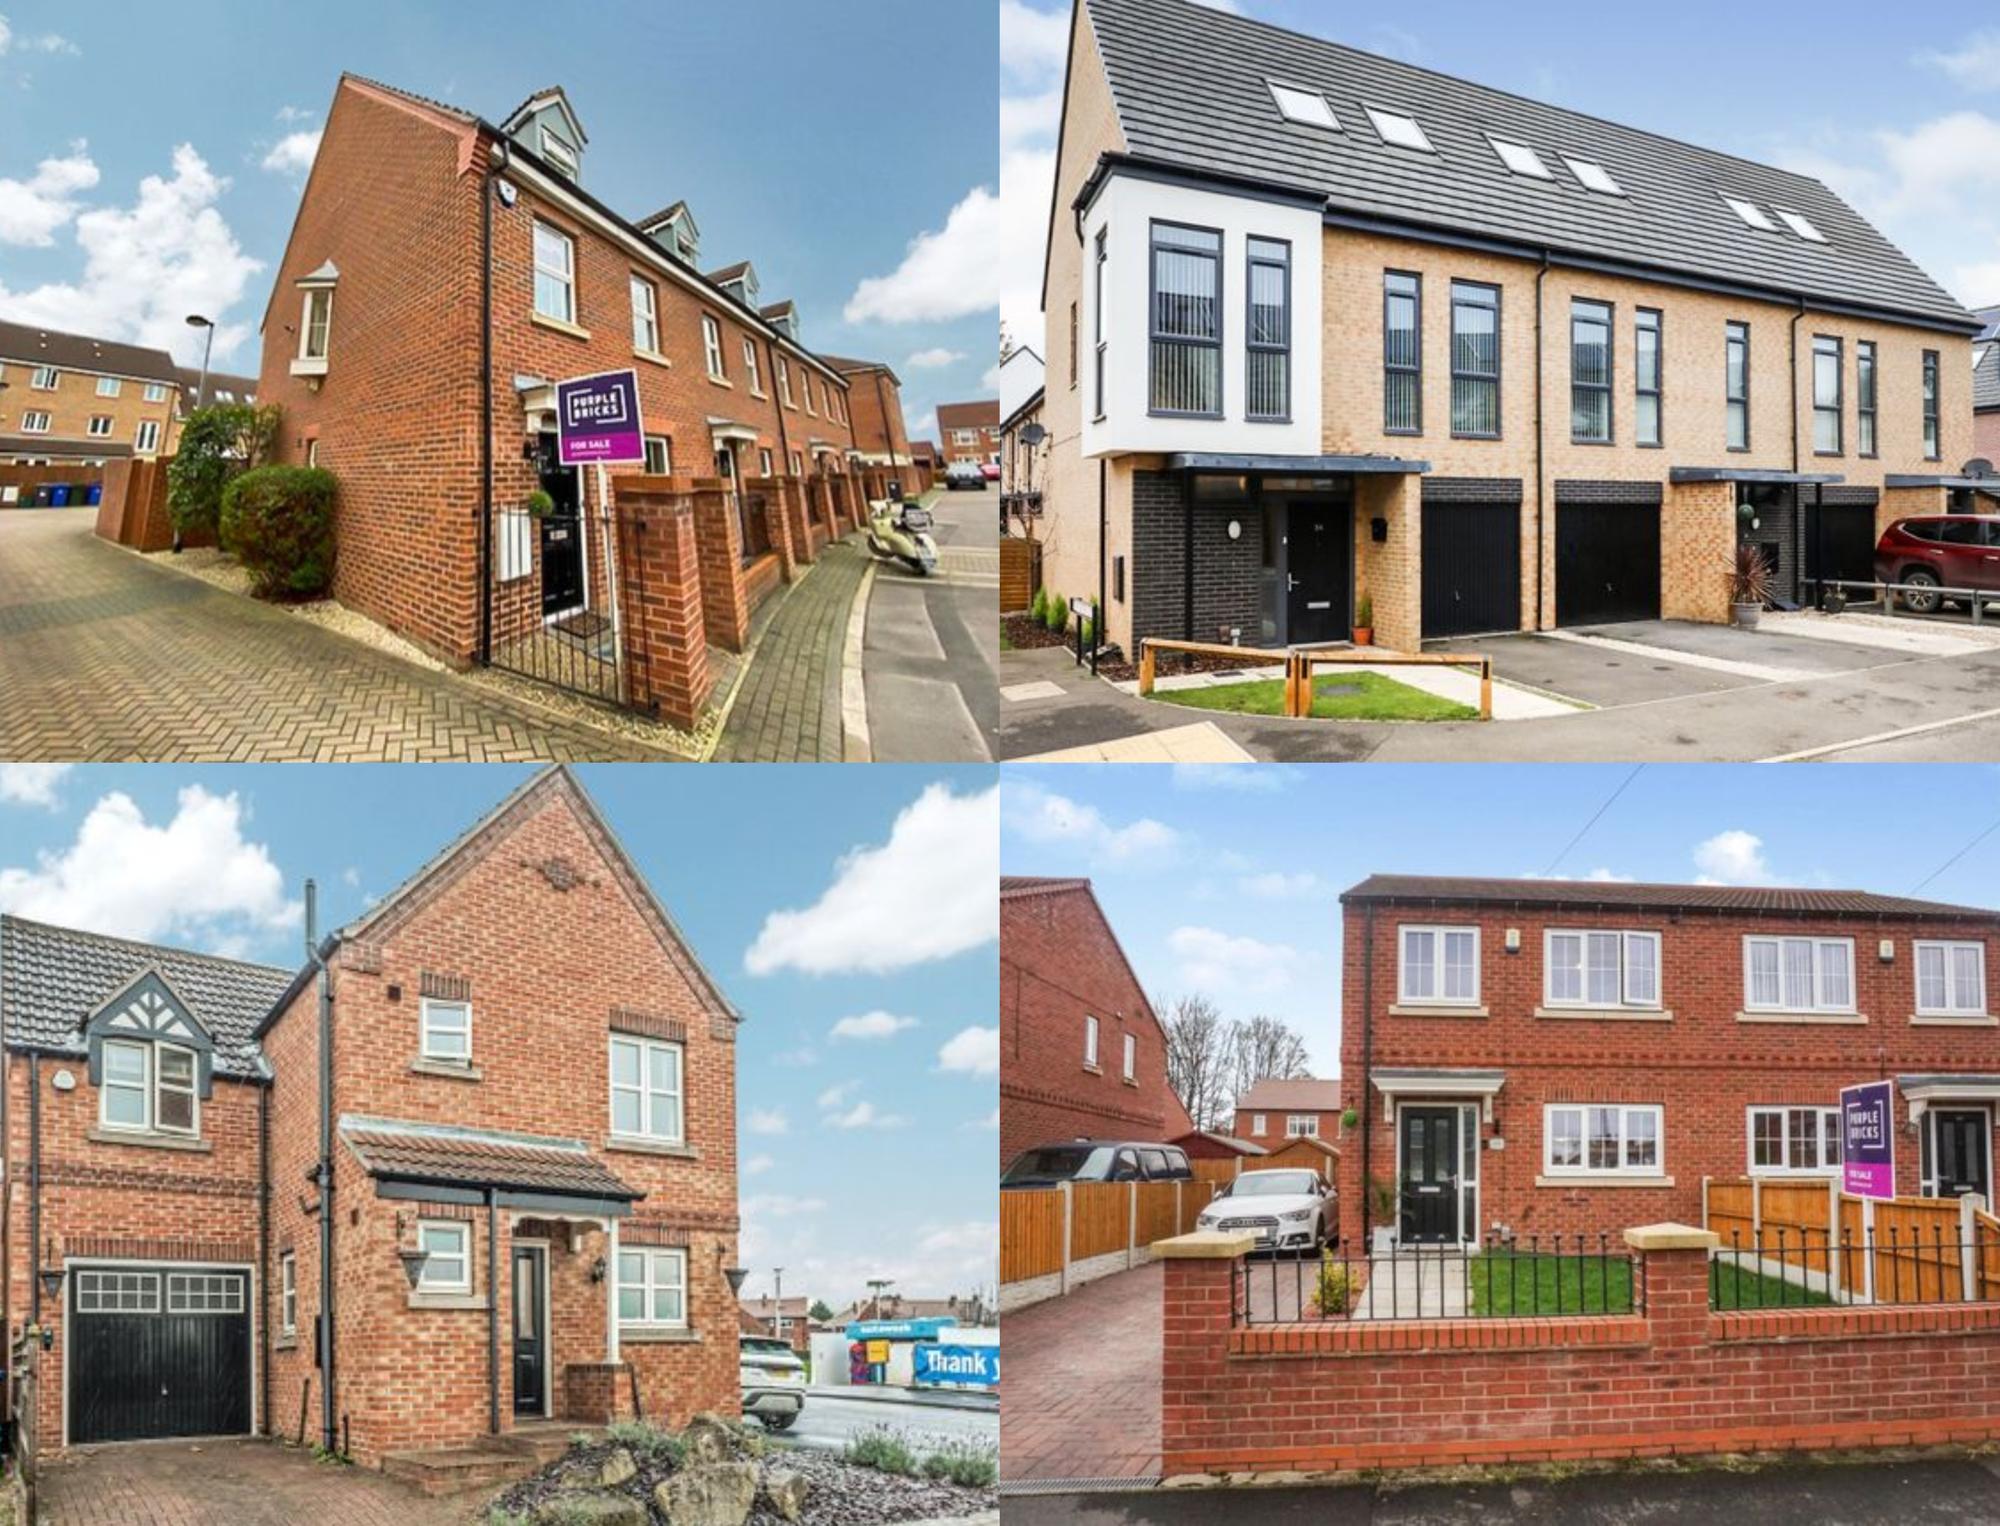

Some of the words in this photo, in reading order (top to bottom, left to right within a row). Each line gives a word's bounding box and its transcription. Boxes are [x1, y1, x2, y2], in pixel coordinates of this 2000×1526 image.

[573, 392, 617, 407] PURPLE
[574, 405, 618, 419] BRICKS
[570, 441, 587, 450] FOR
[589, 440, 611, 448] SALE
[927, 1350, 987, 1374] Thank
